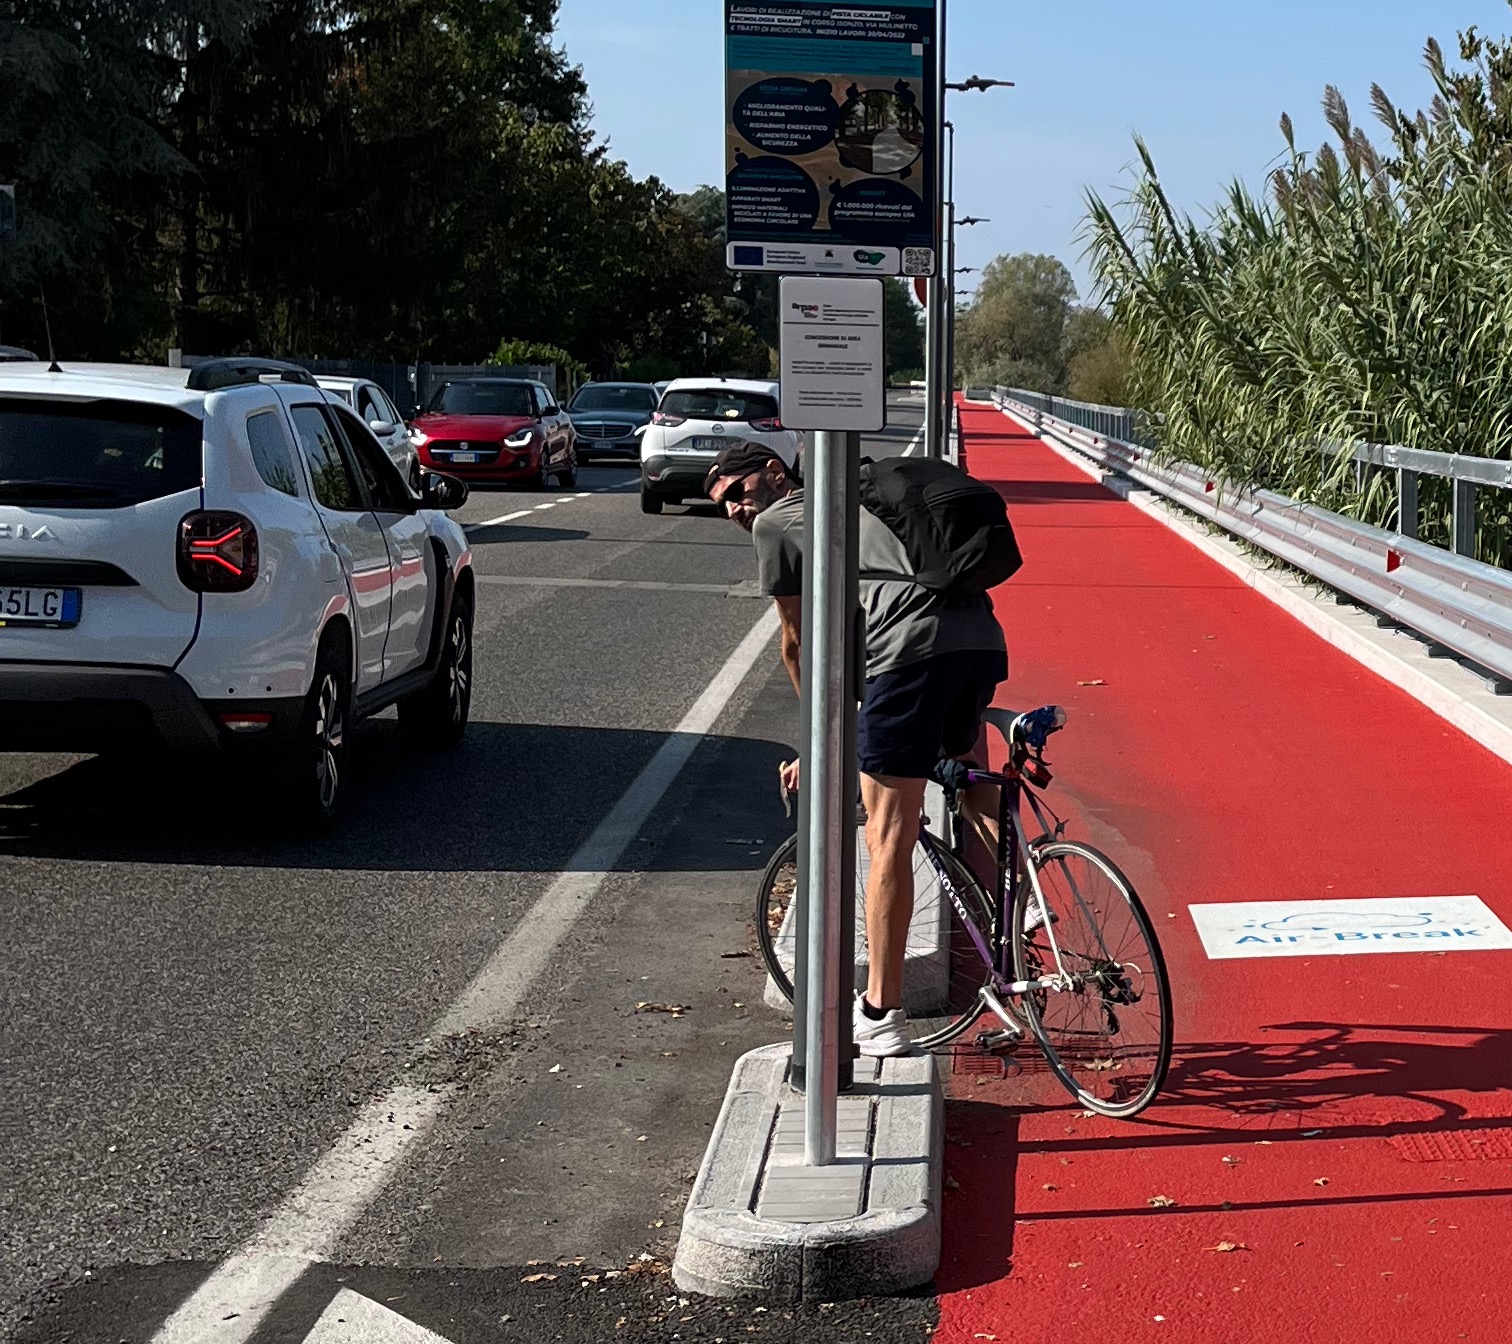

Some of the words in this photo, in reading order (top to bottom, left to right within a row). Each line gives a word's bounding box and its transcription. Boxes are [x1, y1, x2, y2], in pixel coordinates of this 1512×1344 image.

[891, 13, 906, 21] CON
[811, 19, 836, 27] CORSO
[786, 123, 828, 131] ENERGETICO
[0, 589, 59, 617] 5LG
[1235, 927, 1484, 945] Air-Break
